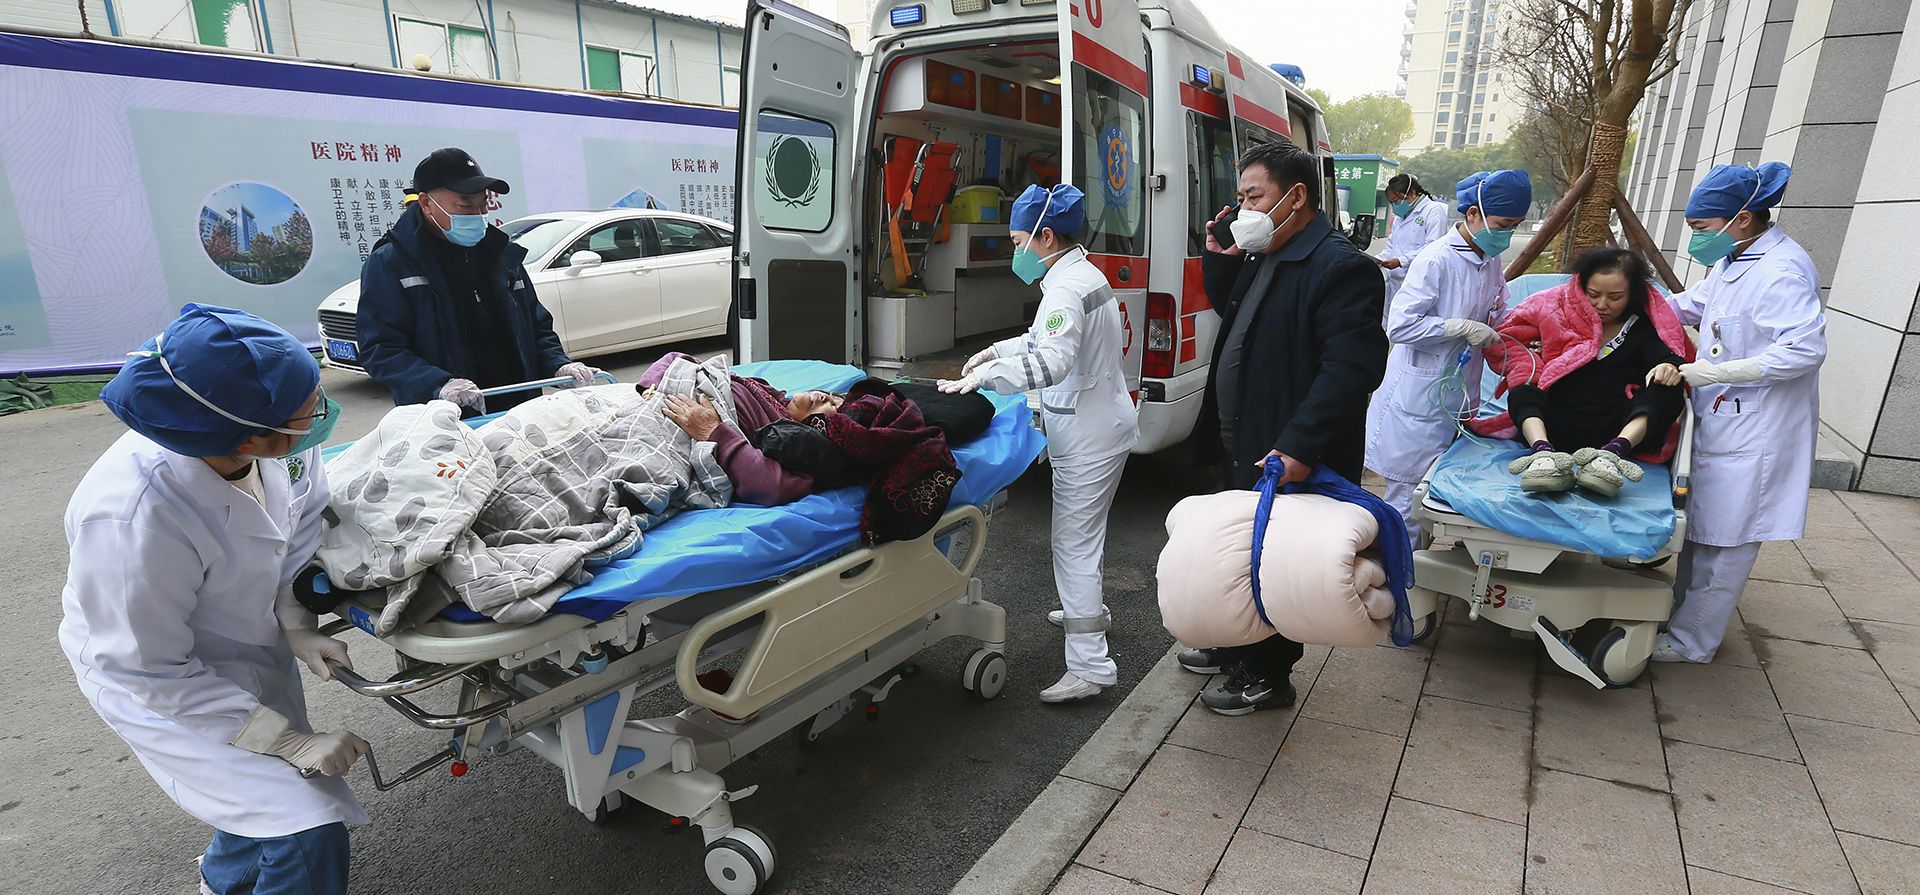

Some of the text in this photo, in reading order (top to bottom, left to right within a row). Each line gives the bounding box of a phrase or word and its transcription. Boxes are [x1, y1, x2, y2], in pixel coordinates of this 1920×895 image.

[311, 141, 402, 162] 医院精神
[671, 158, 719, 173] 医院精神
[364, 178, 382, 237] 人敢于担当
